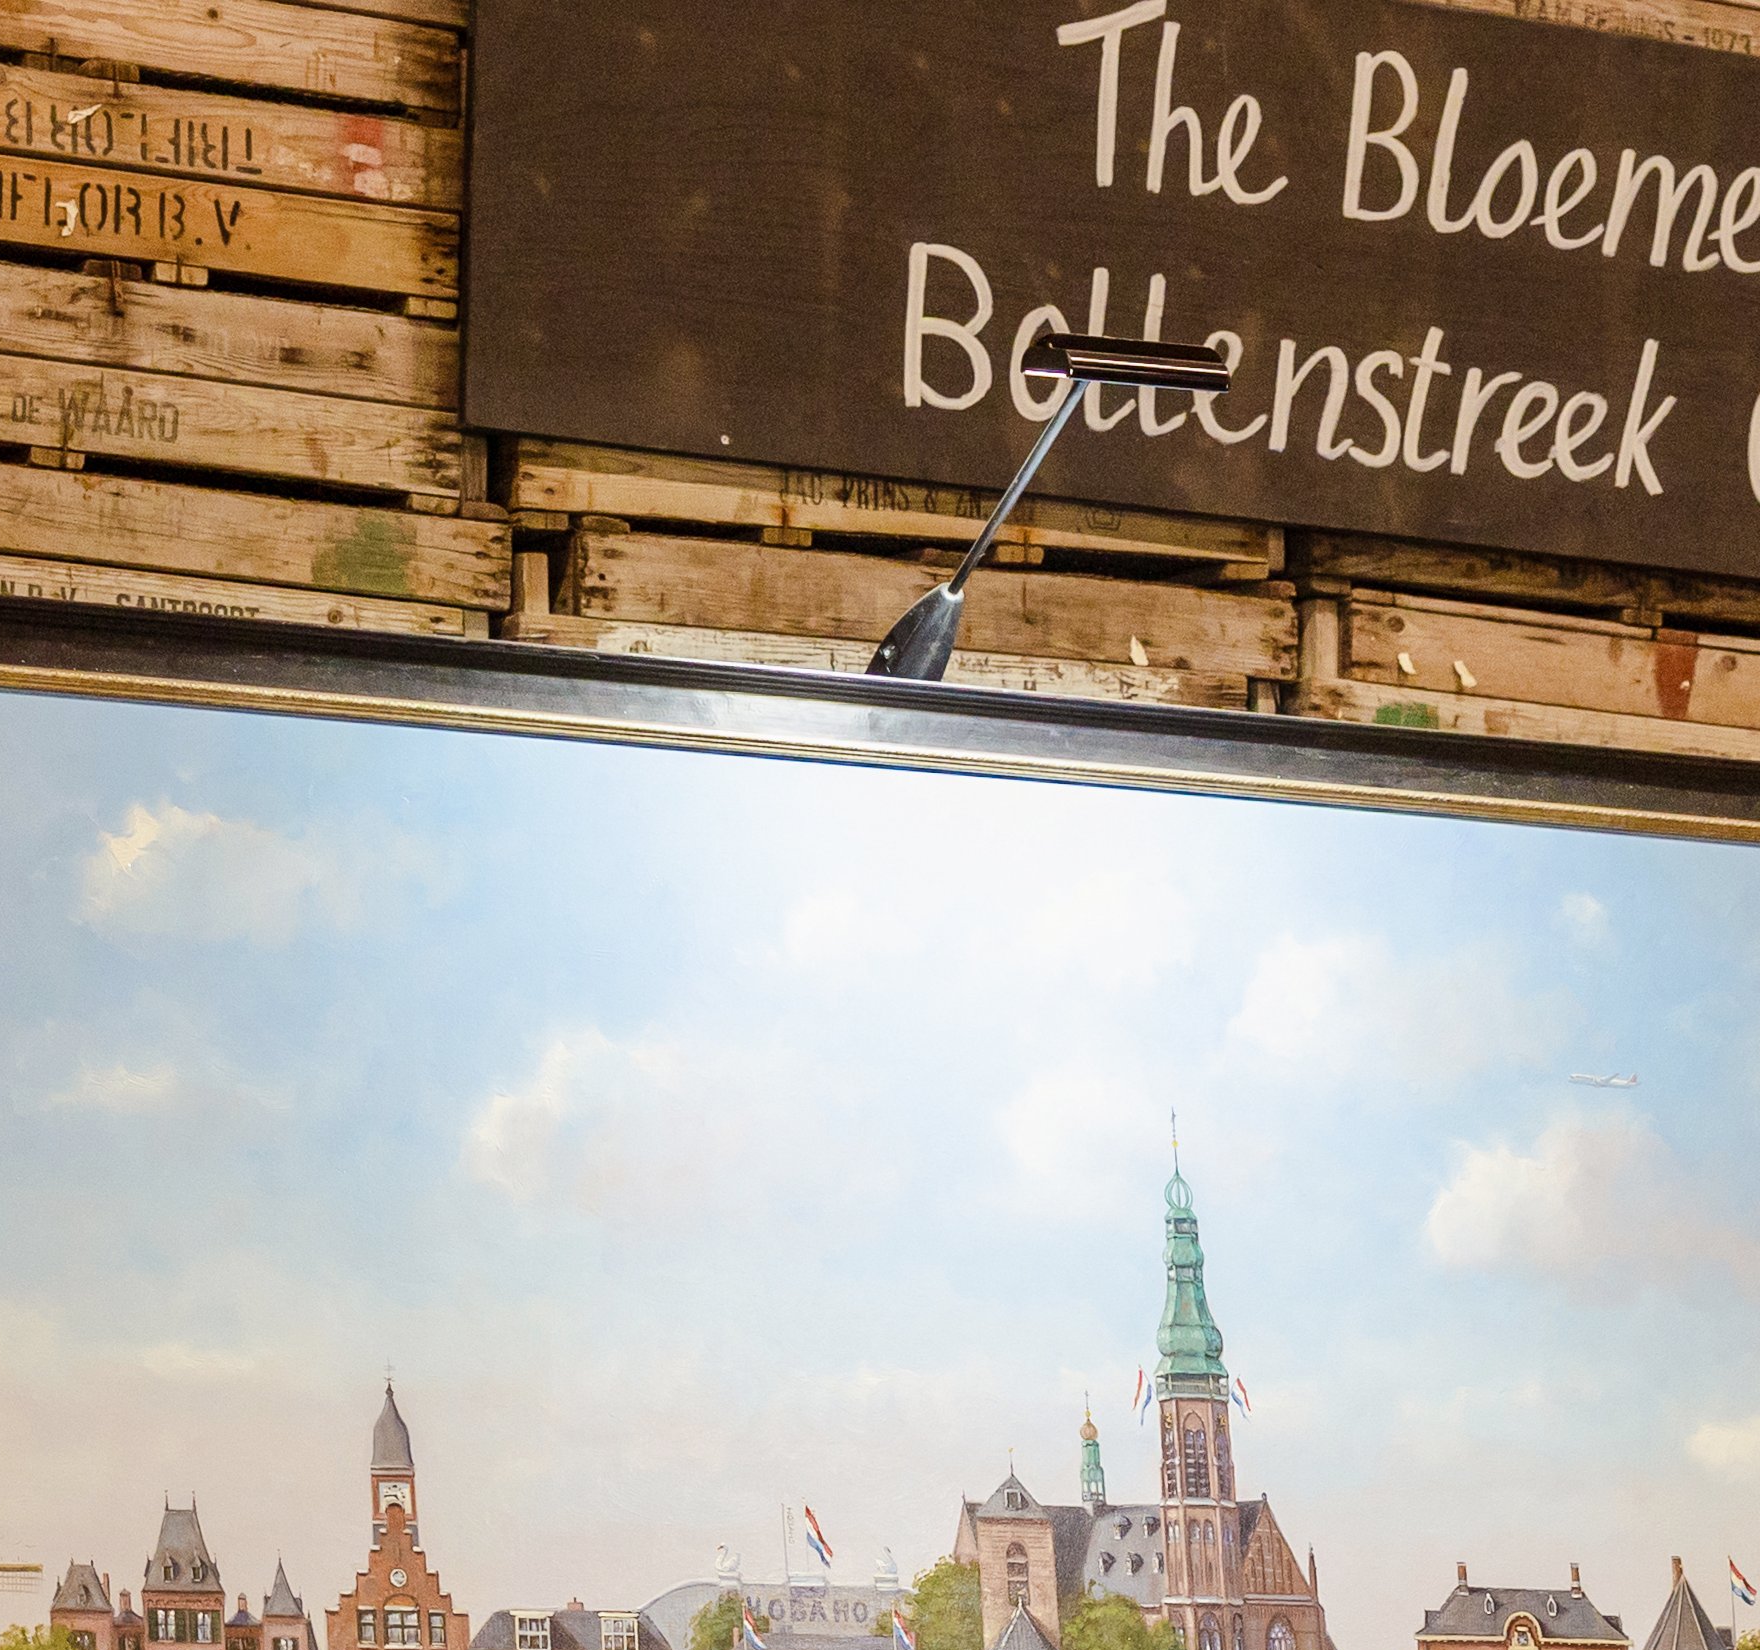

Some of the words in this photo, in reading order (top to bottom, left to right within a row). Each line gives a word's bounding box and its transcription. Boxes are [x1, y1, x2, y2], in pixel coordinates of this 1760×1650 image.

[50, 104, 262, 175] TRIFLOR
[1056, 0, 1288, 204] The
[11, 392, 42, 425] DE
[904, 242, 1676, 495] Bollenstreek
